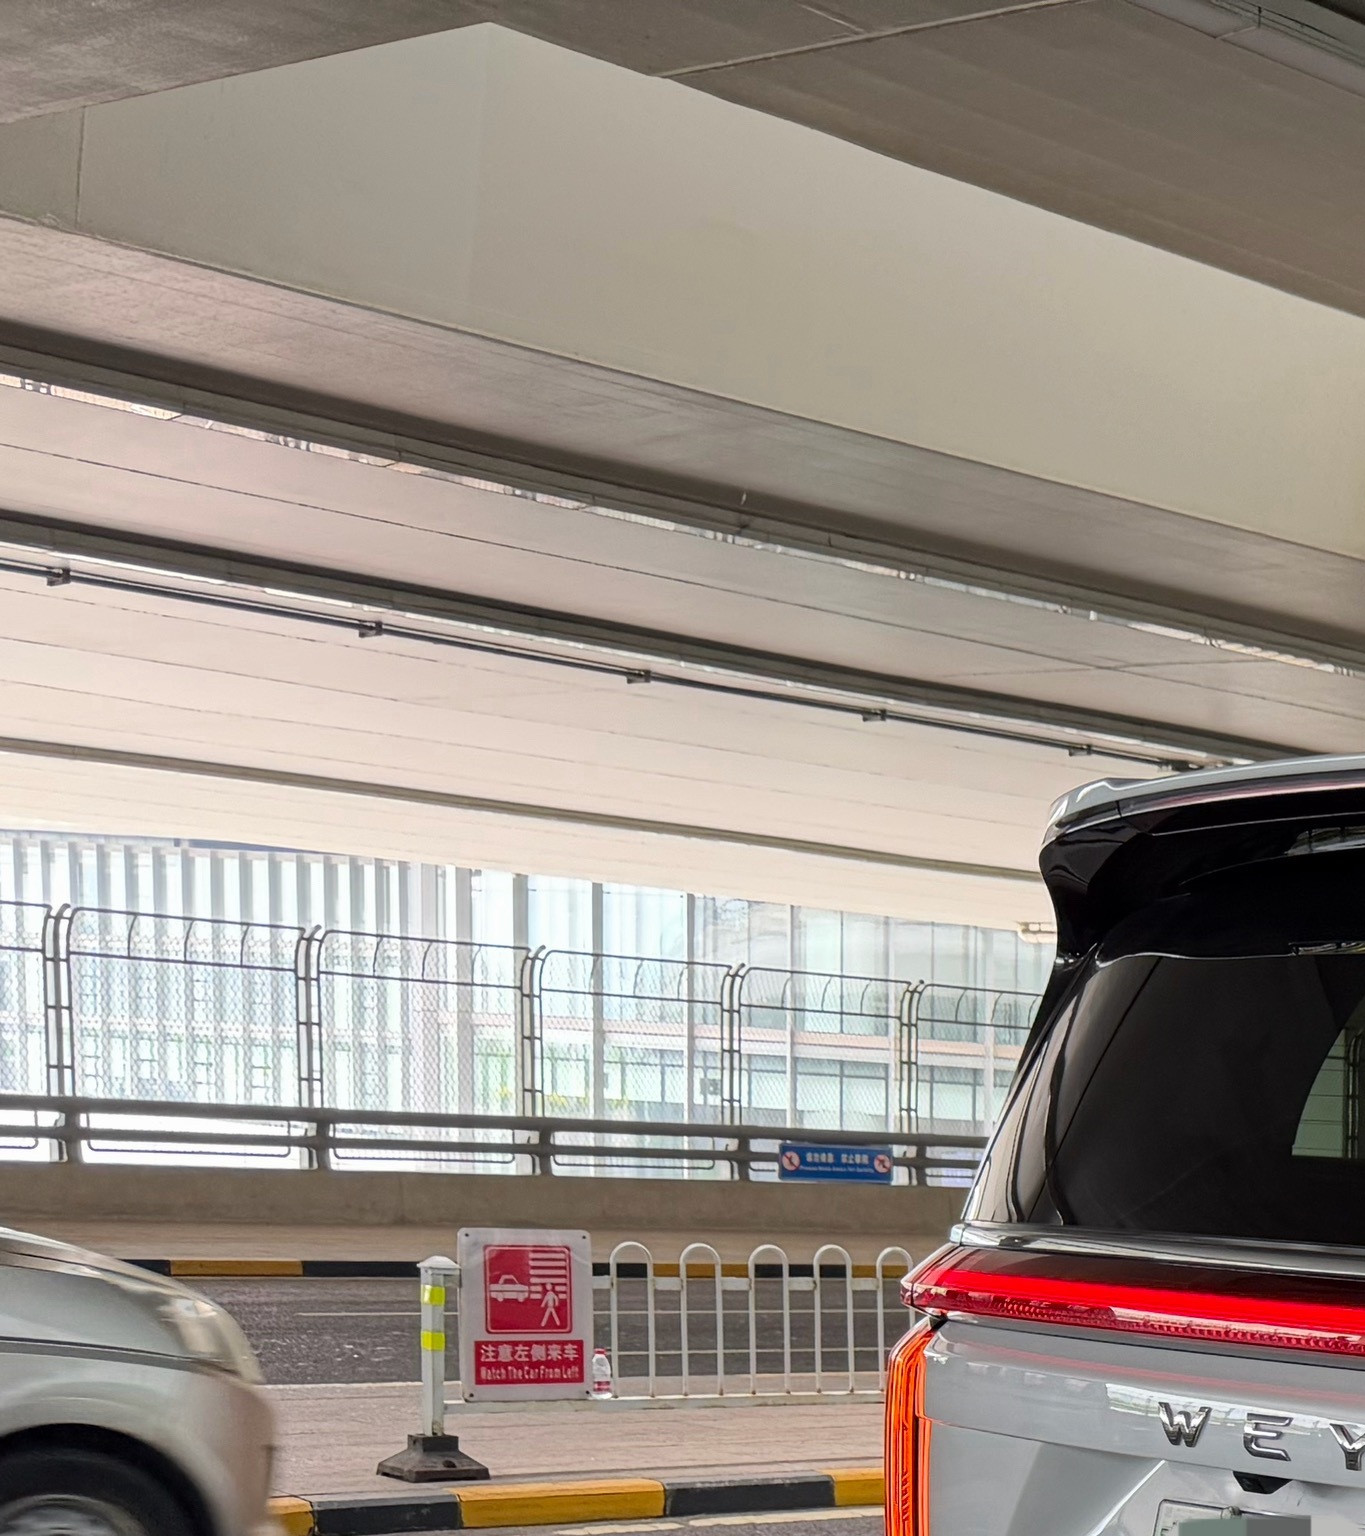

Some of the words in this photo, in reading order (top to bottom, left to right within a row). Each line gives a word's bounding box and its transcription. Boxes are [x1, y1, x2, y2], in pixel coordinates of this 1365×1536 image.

[480, 1343, 579, 1362] 注意左侧来车
